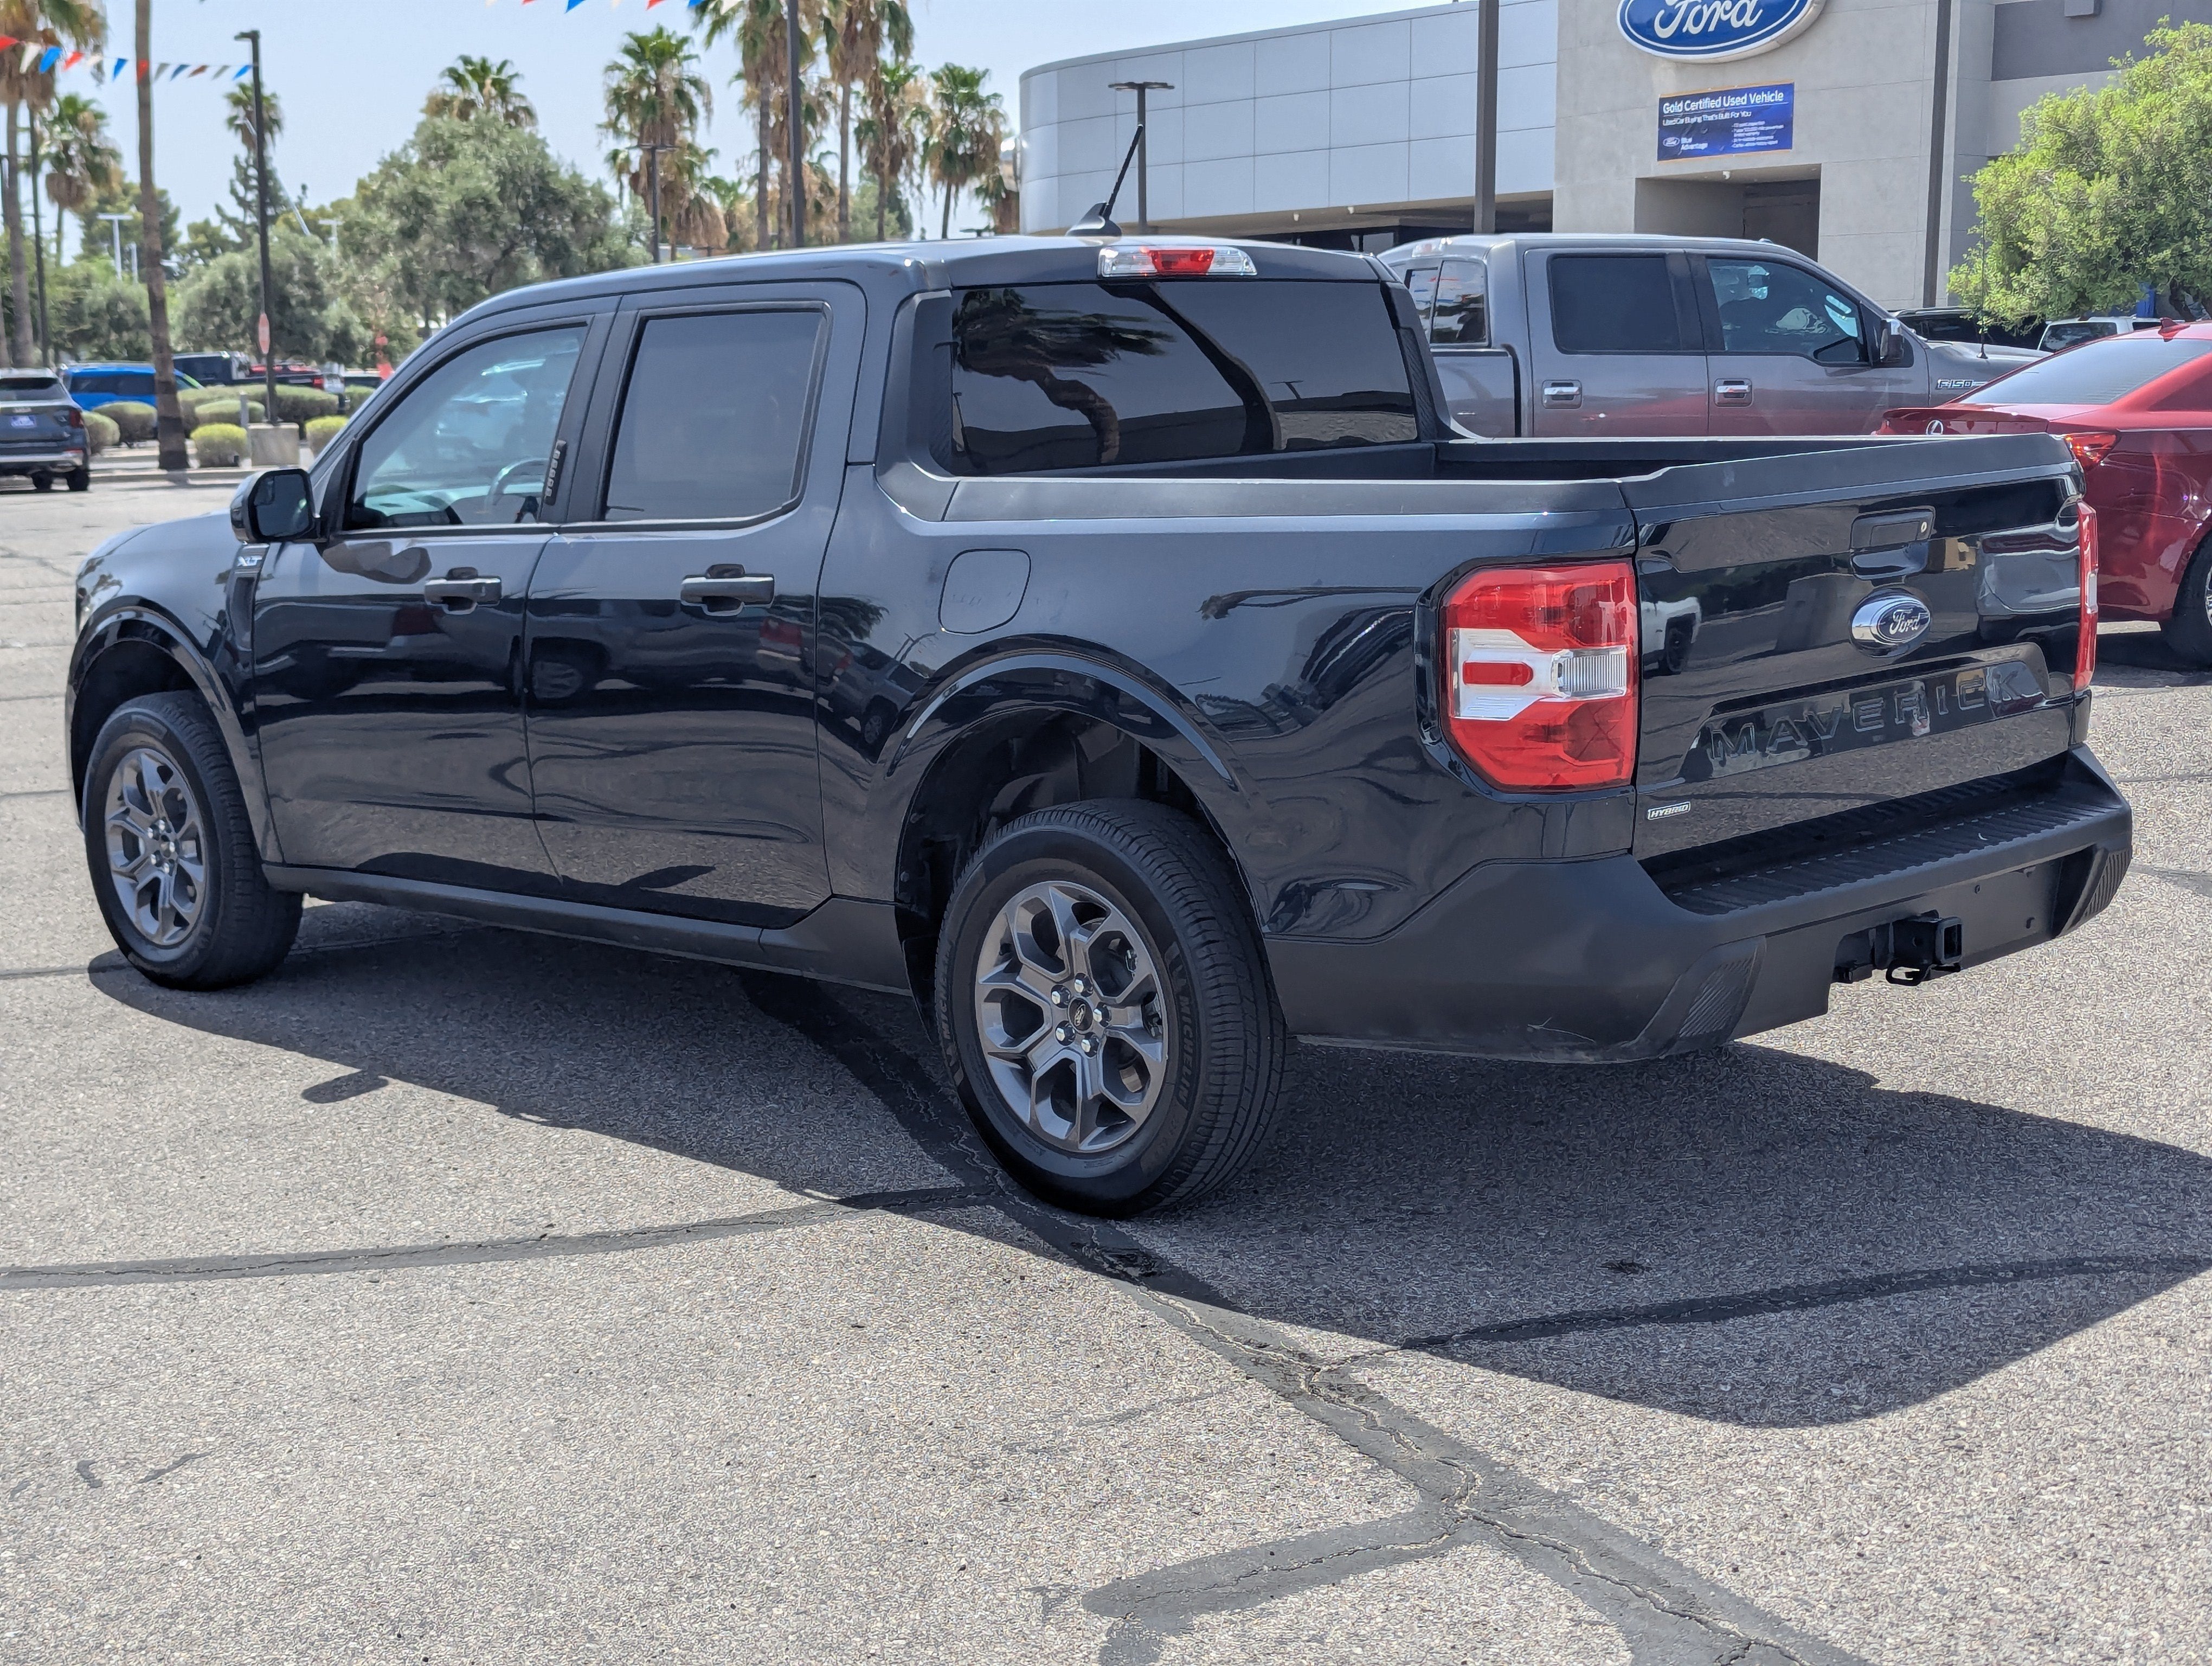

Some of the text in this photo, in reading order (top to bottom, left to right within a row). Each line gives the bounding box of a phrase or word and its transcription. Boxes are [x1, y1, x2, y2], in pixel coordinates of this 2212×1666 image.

[1663, 89, 1784, 114] Gold Certified Used Vehicle
[237, 555, 262, 567] XLT
[1889, 608, 1920, 635] Ford
[1711, 671, 2022, 760] MAVERICK
[1650, 804, 1689, 818] HYBRID
[1178, 995, 1194, 1103] MICHELIN
